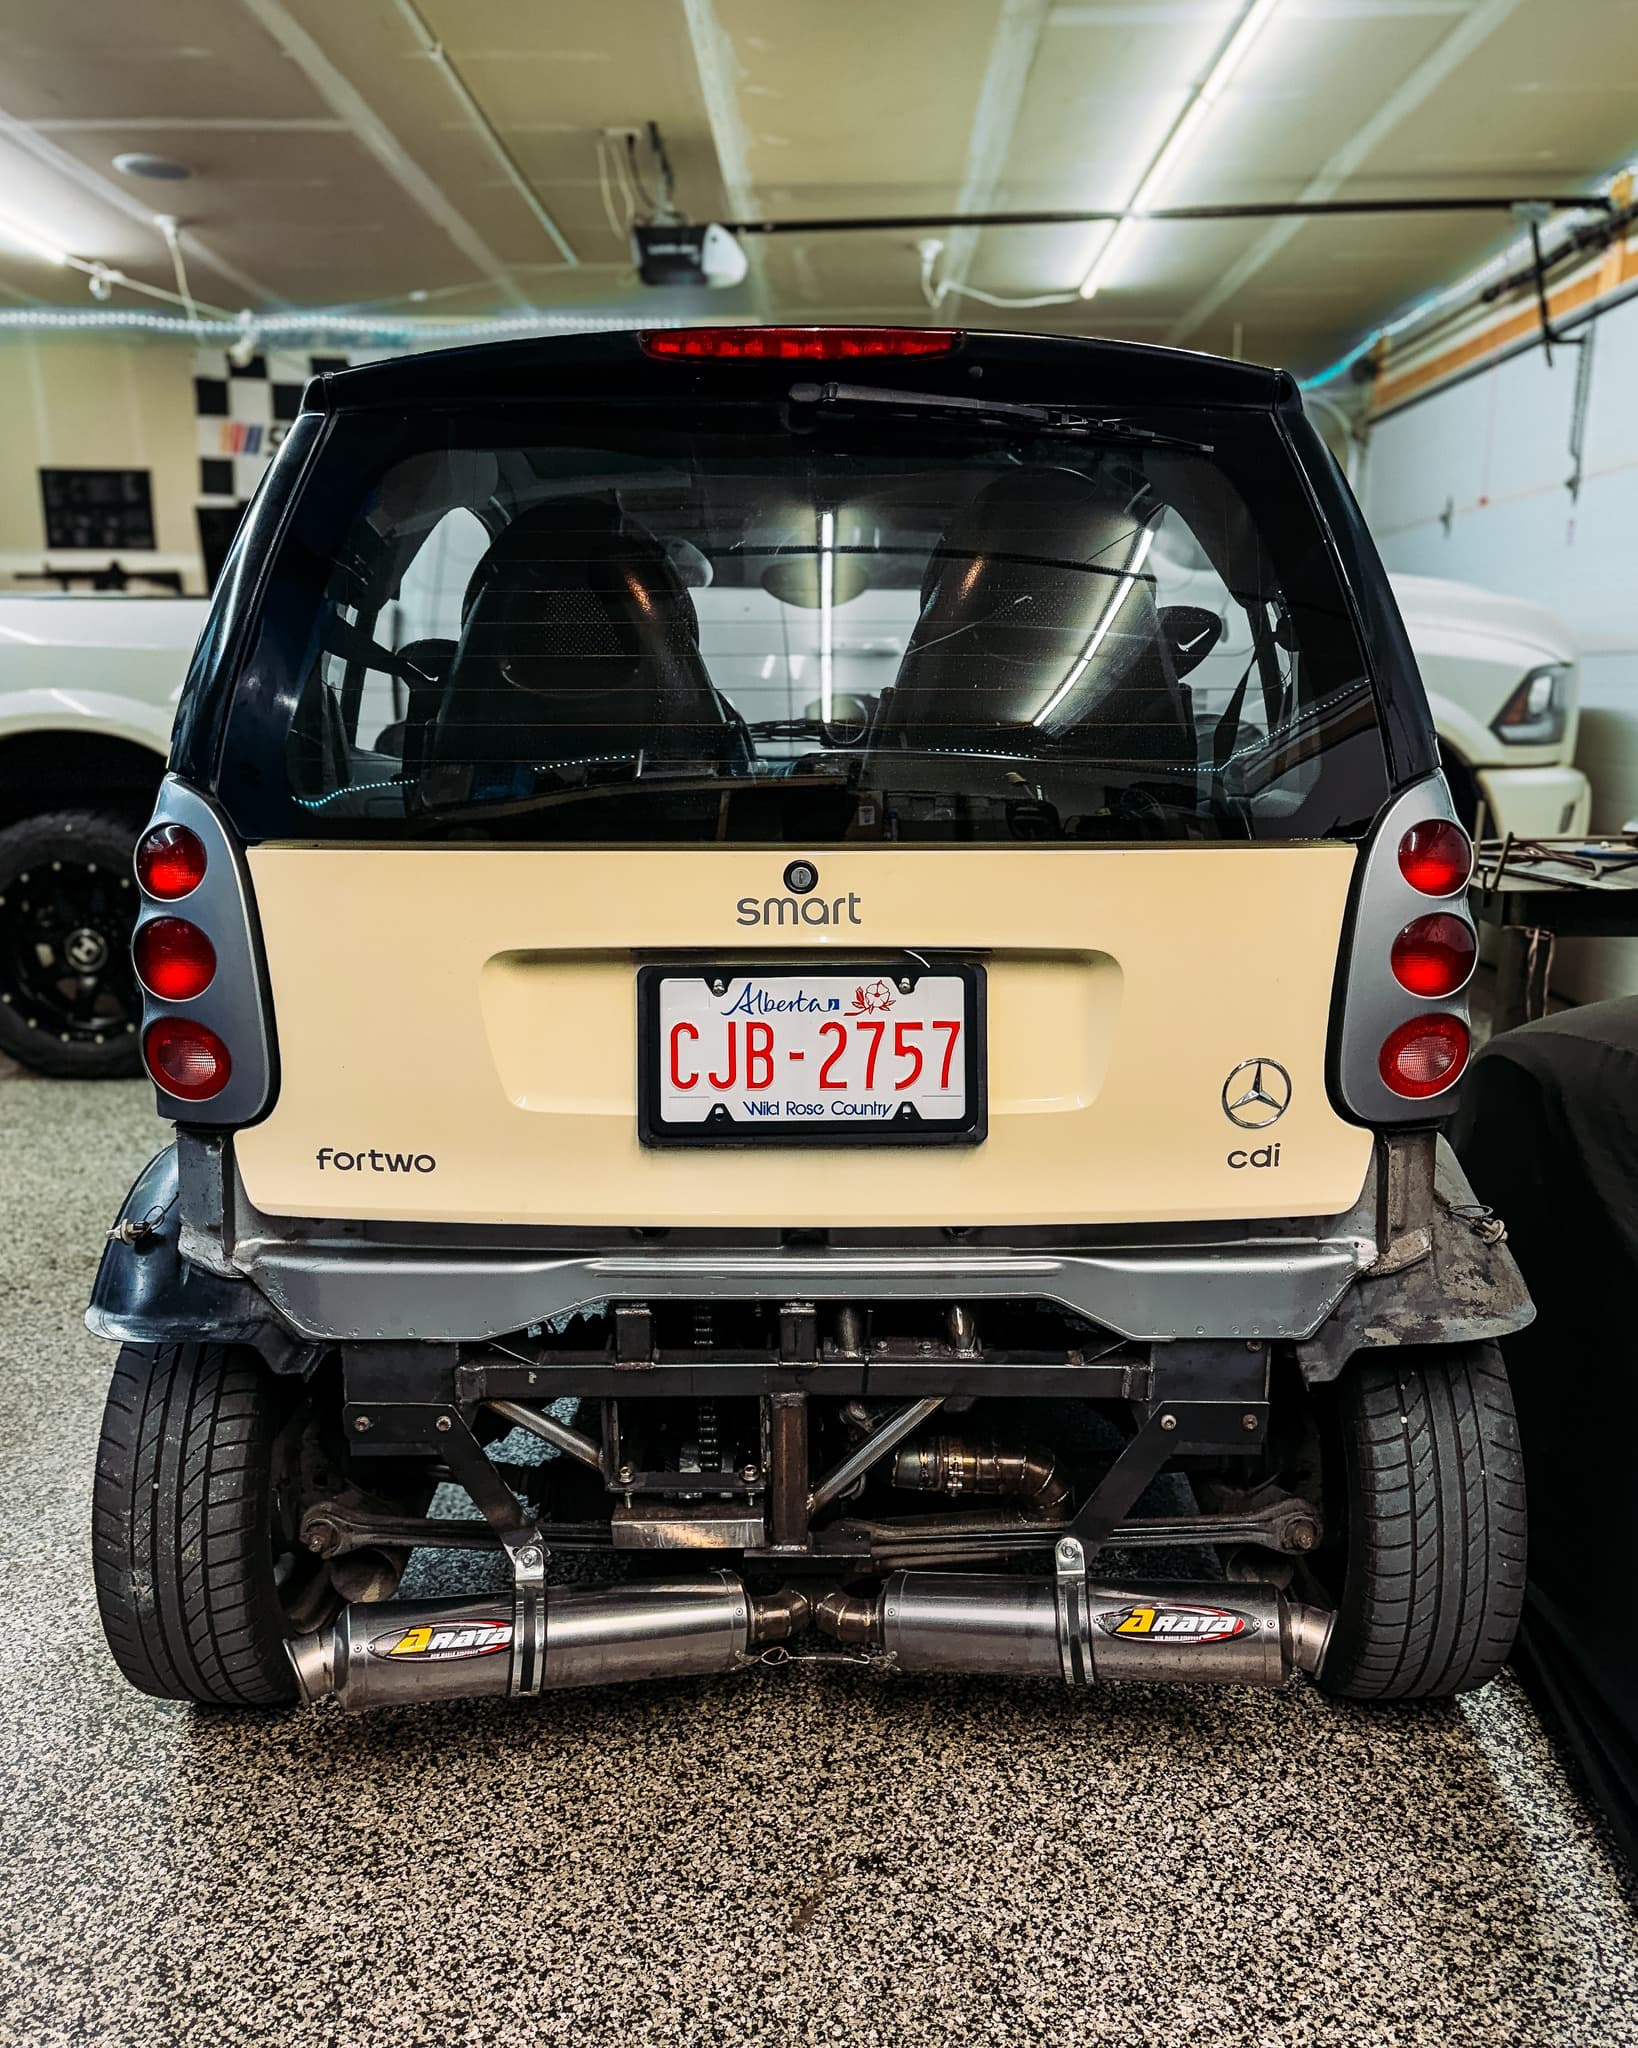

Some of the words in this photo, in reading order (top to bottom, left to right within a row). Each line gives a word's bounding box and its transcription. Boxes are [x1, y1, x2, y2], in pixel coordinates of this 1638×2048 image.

[736, 892, 862, 926] smart
[720, 982, 829, 1015] Alberta
[670, 1021, 961, 1090] CJB-2757
[743, 1101, 780, 1116] Wild
[786, 1101, 825, 1117] Rose
[831, 1100, 893, 1118] Country
[316, 1147, 437, 1173] fortwo
[1227, 1142, 1281, 1169] cdi
